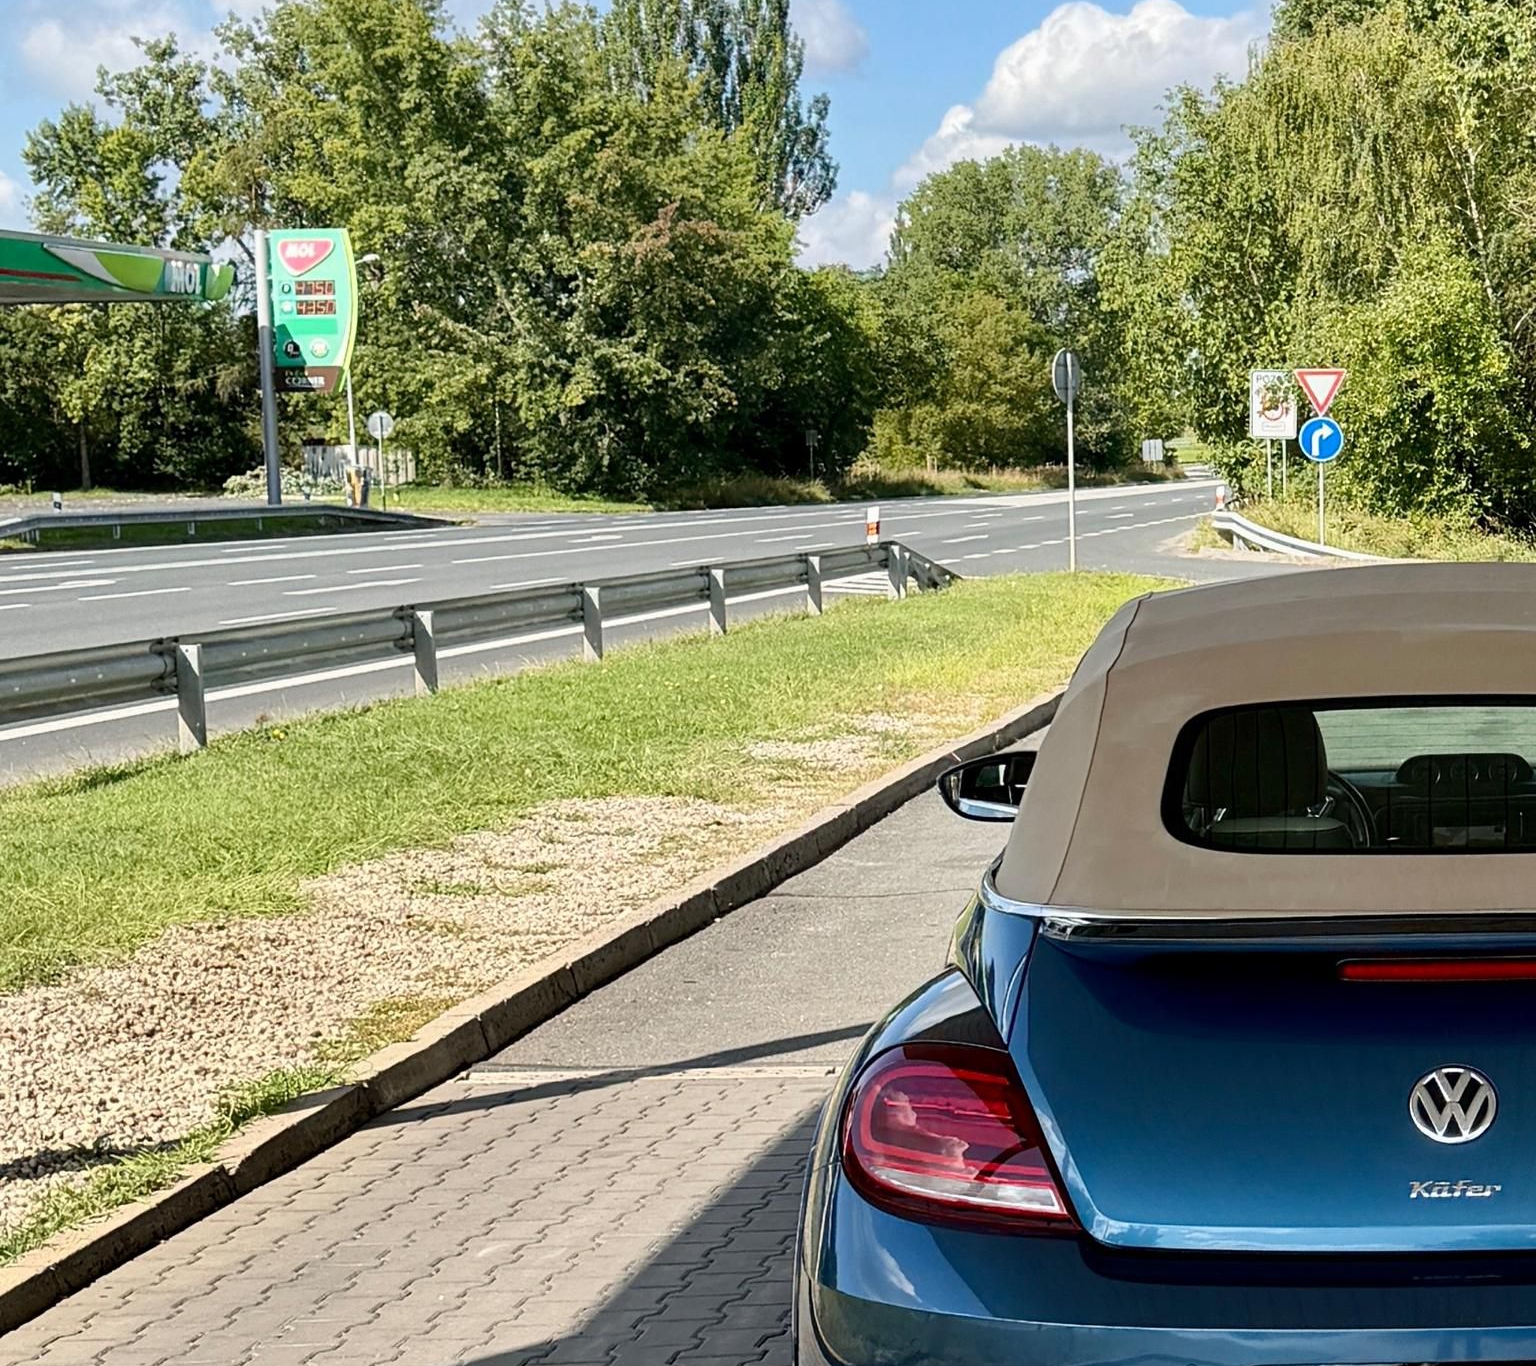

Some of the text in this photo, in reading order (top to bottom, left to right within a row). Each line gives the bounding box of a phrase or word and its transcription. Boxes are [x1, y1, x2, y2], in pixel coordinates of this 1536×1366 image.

[285, 243, 315, 258] MOL
[170, 260, 202, 294] MOL
[1409, 1179, 1502, 1199] Käfer
